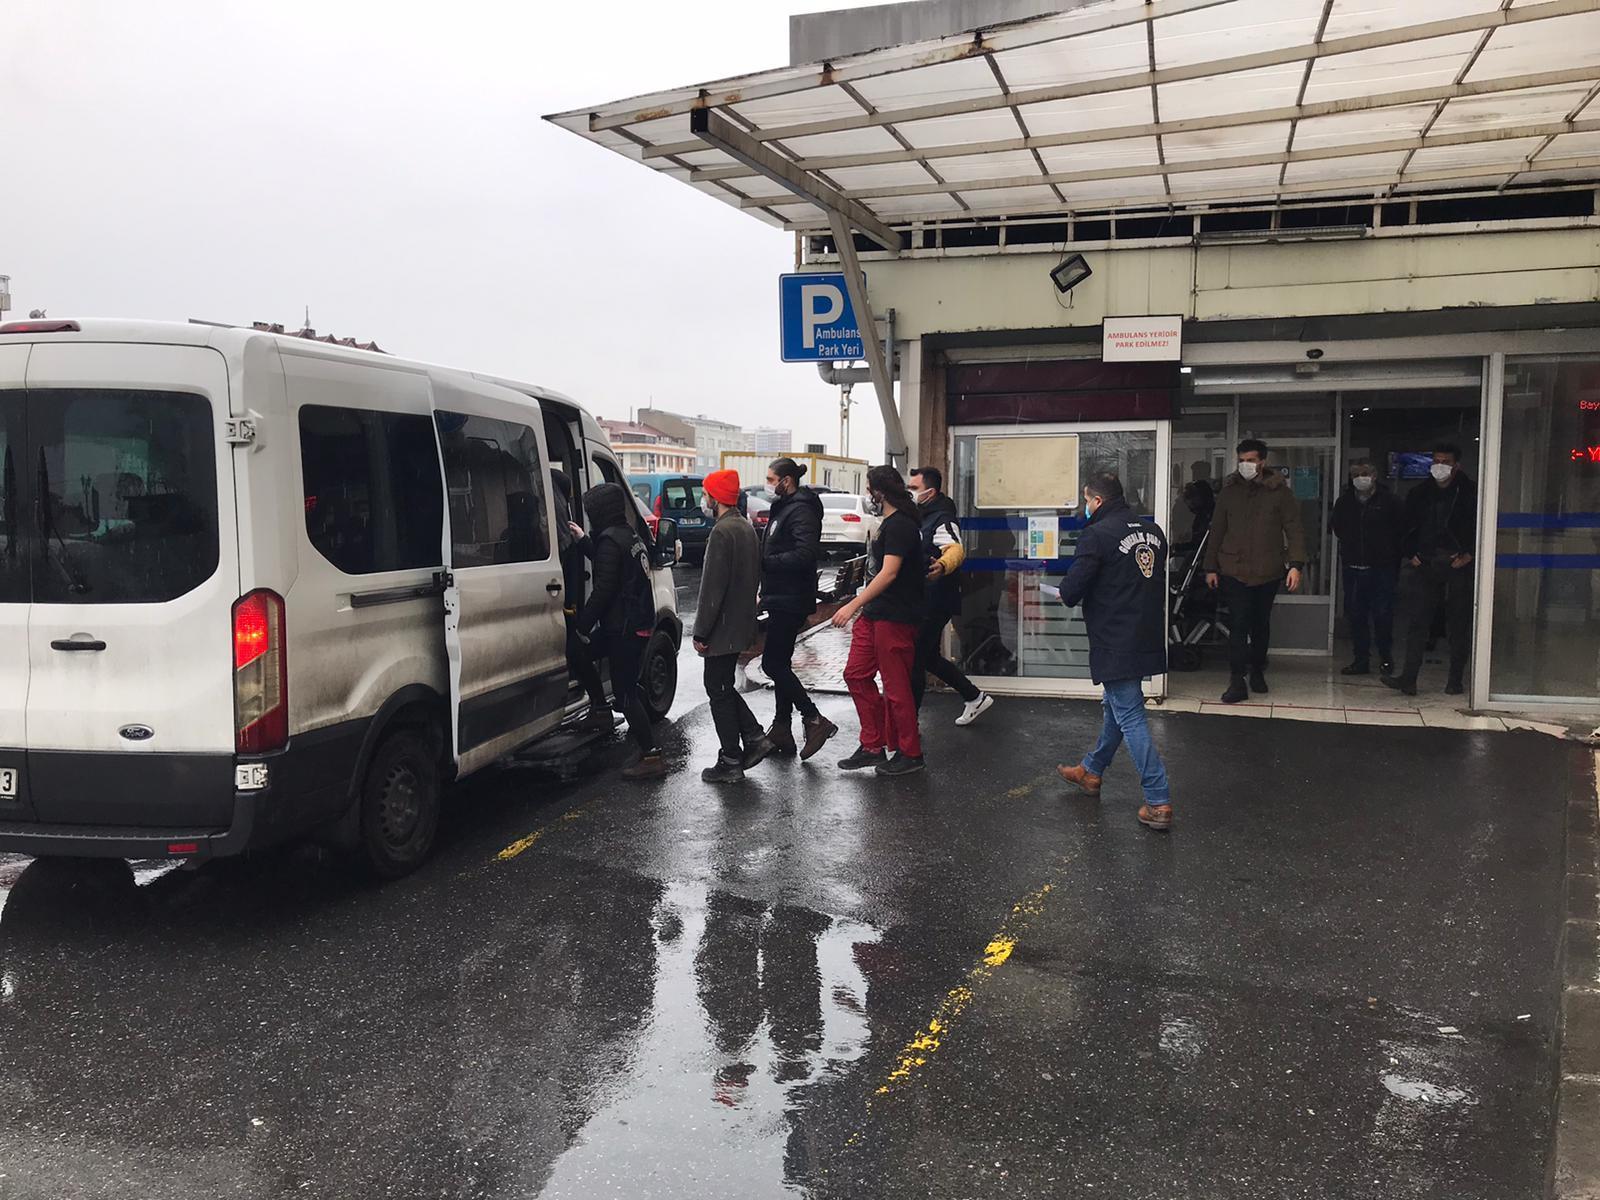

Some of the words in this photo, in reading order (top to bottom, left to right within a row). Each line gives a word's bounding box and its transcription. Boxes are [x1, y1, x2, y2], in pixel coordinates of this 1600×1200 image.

[801, 284, 844, 349] P
[815, 327, 862, 340] Ambulans
[1107, 331, 1148, 340] AMBULANS
[1149, 329, 1178, 338] YERİDİR
[818, 344, 840, 356] Park
[841, 343, 860, 355] Yeri
[1579, 400, 1600, 411] Bay
[1587, 446, 1600, 461] Y
[2, 771, 13, 792] 3
